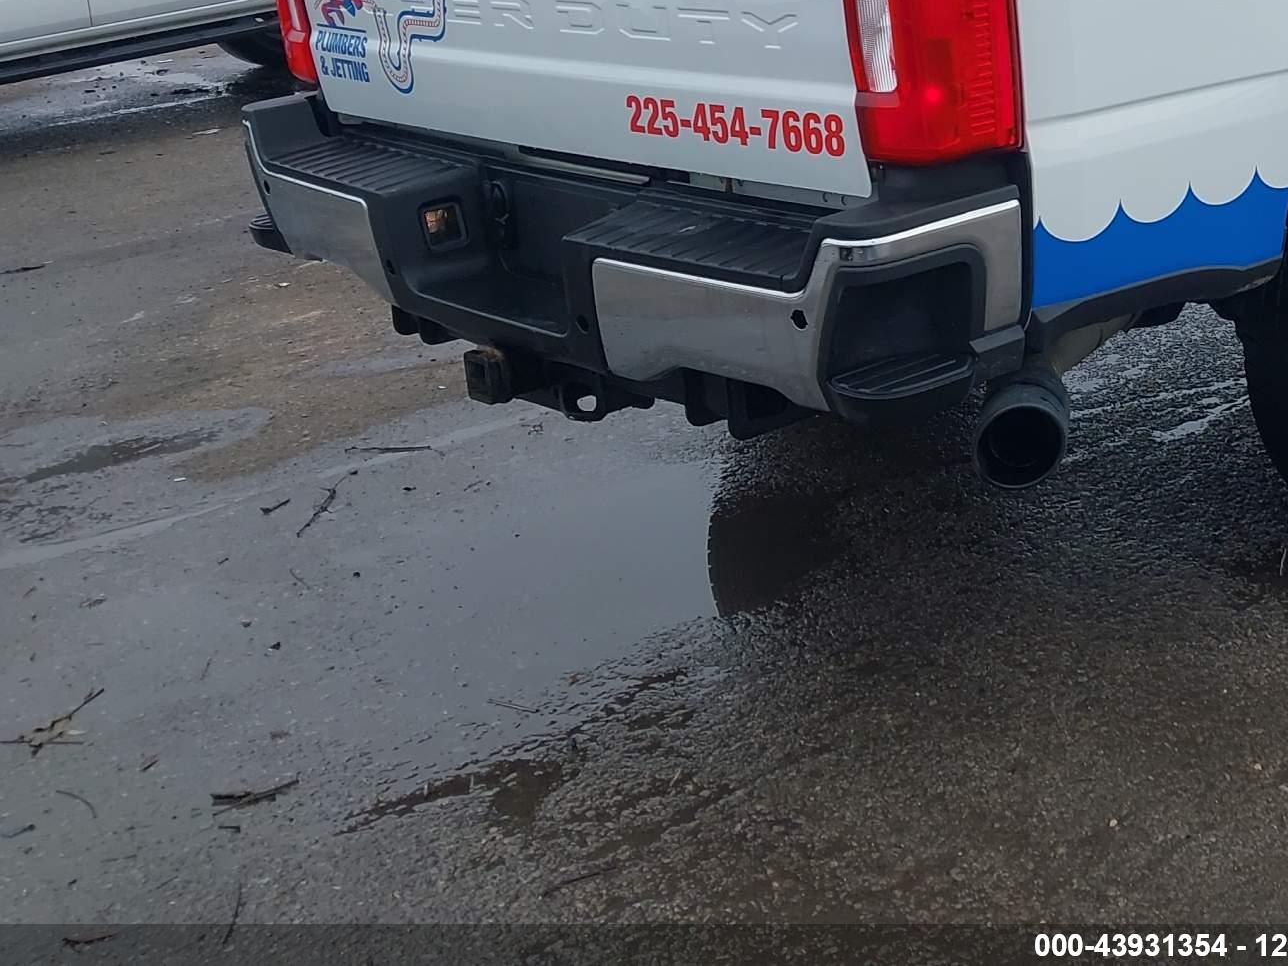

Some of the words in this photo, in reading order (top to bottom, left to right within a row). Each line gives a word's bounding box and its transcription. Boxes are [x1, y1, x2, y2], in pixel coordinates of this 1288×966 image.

[556, 0, 798, 49] DUTY
[315, 30, 368, 58] PLUMBERS
[320, 56, 329, 75] &
[330, 58, 370, 83] JETTING
[626, 95, 845, 157] 225-454-7668
